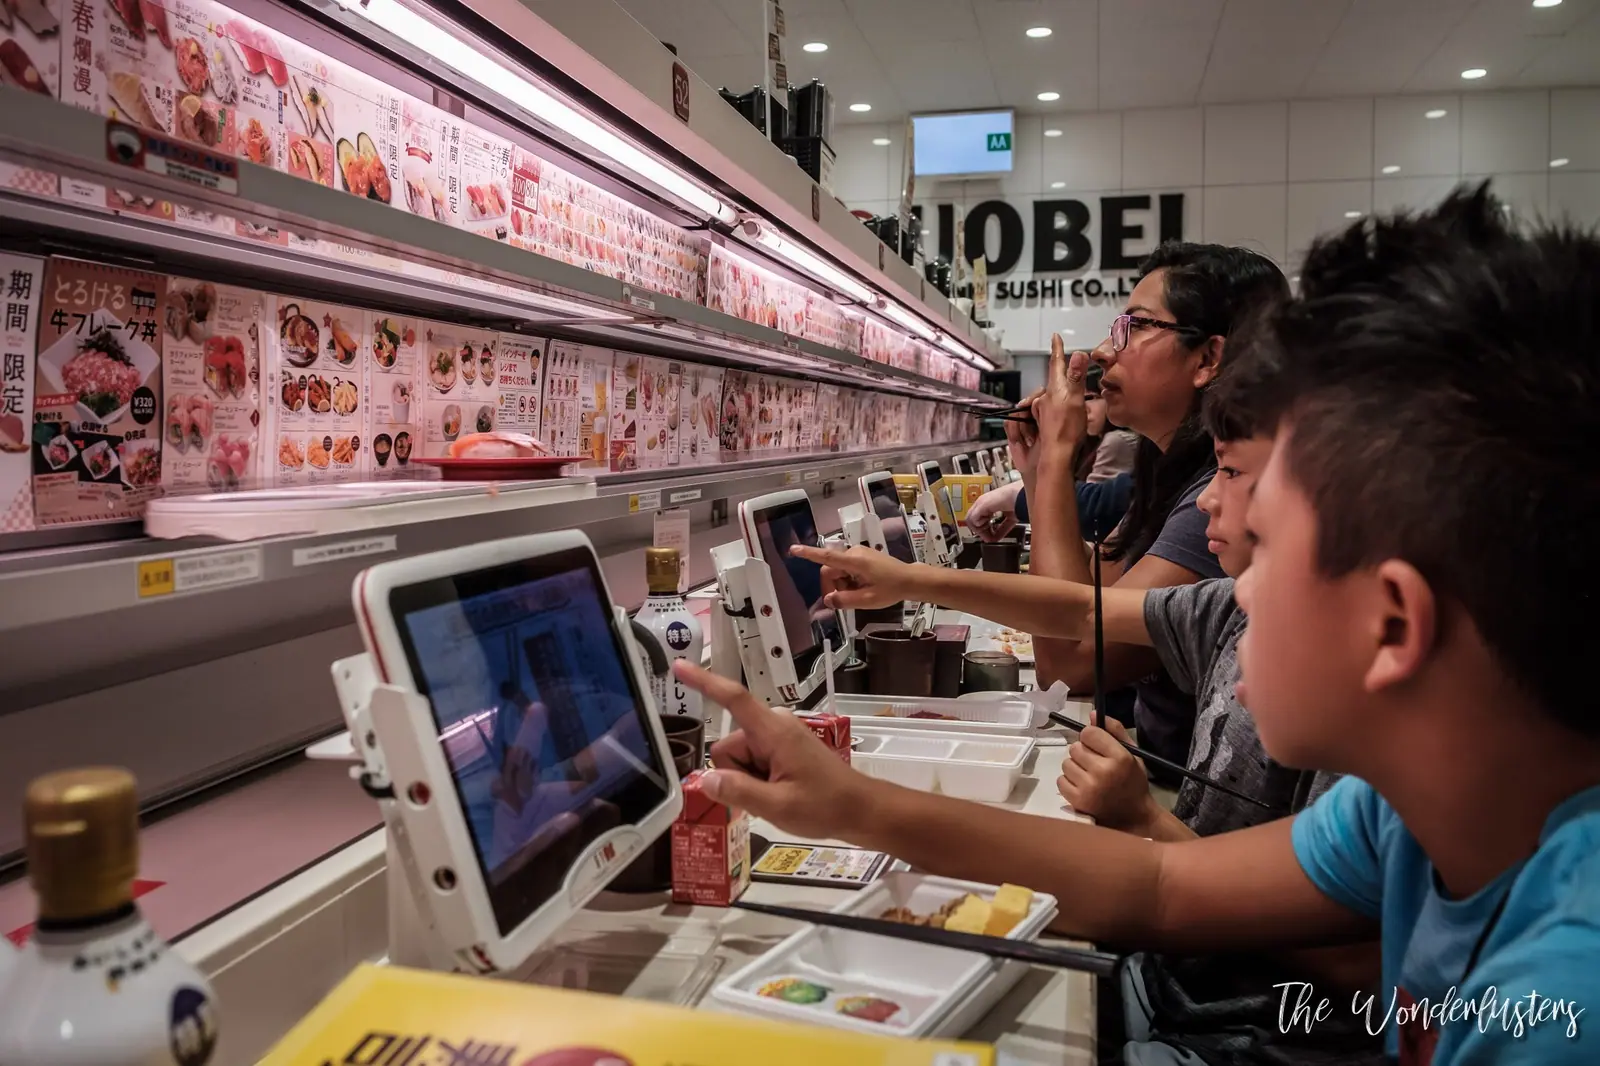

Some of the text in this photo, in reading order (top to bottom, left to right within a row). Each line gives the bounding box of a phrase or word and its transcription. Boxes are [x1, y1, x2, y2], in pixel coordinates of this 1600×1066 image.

[675, 74, 689, 109] 52
[388, 98, 399, 180] 期間限定
[990, 135, 1007, 149] AA
[449, 126, 460, 214] 期間限定
[55, 275, 126, 310] とろける
[995, 277, 1063, 300] SUSHI
[2, 269, 33, 415] 期間限定
[50, 308, 157, 342] 牛フレーク丼
[134, 397, 153, 408] ¥320
[667, 628, 691, 643] 特製
